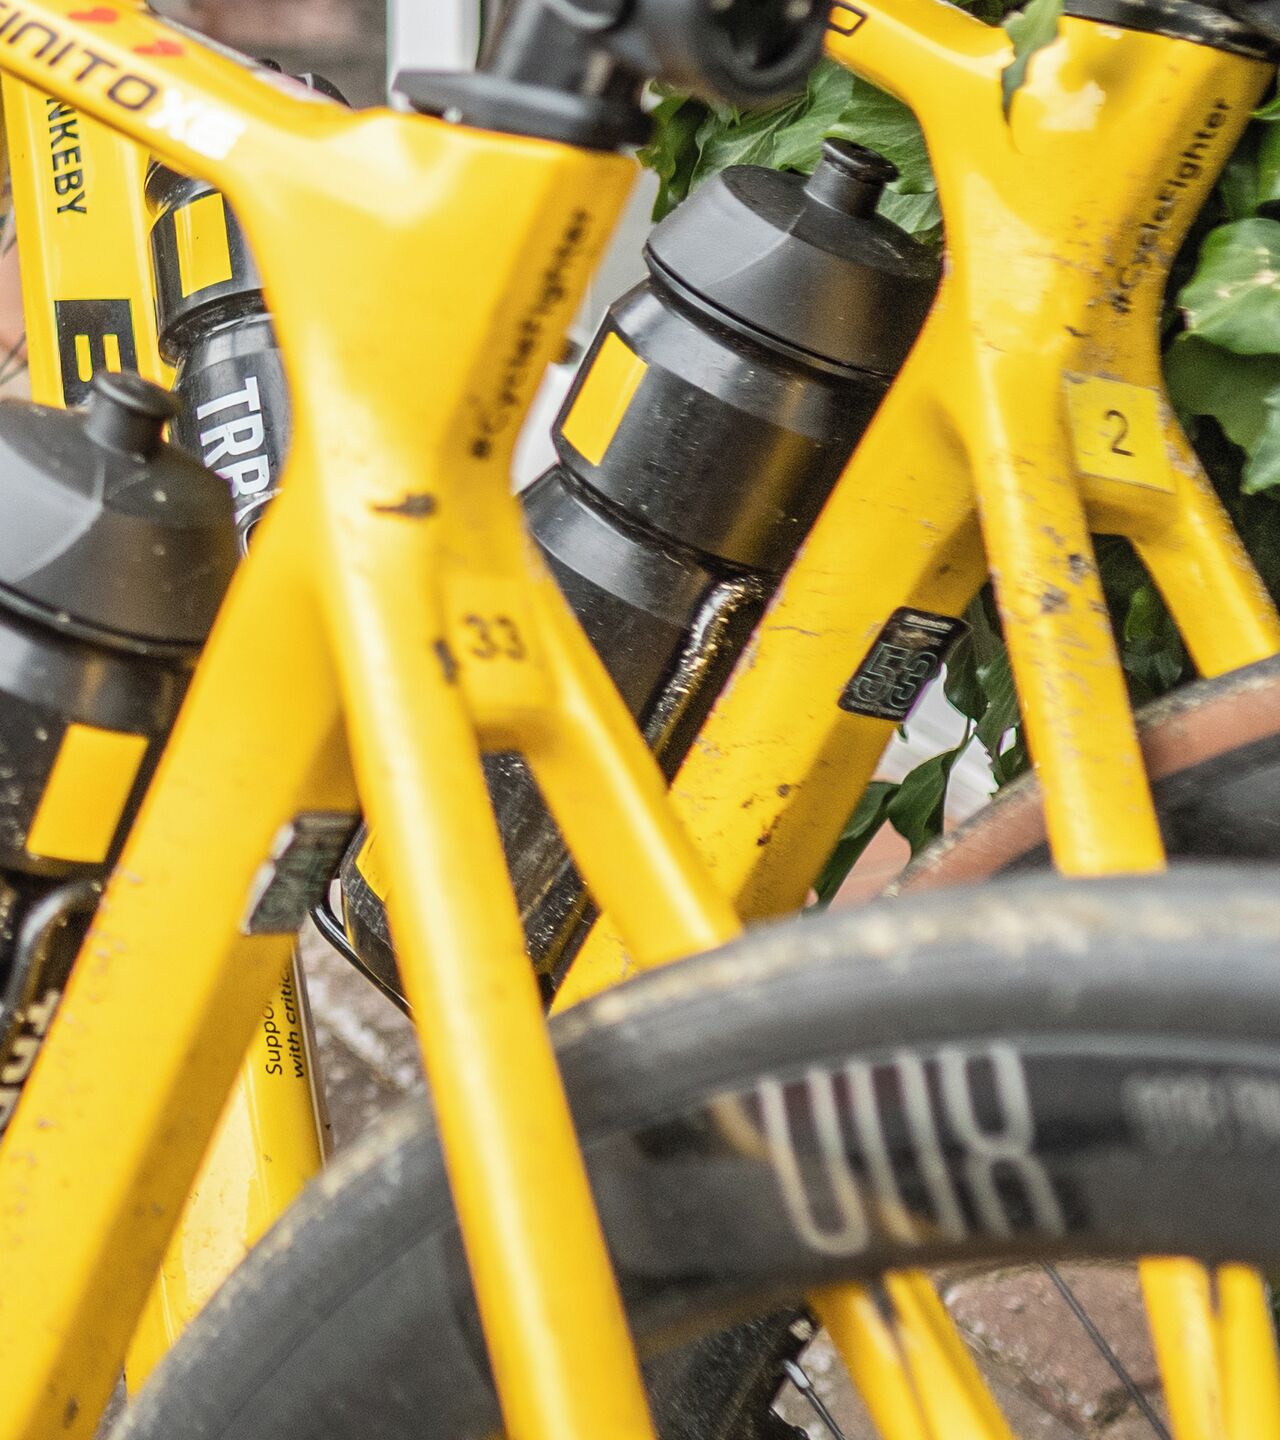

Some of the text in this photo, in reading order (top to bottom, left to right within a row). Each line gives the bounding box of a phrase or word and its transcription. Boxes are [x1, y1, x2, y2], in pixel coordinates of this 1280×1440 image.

[1103, 409, 1135, 457] 2
[462, 612, 527, 661] 33
[287, 1031, 305, 1079] with
